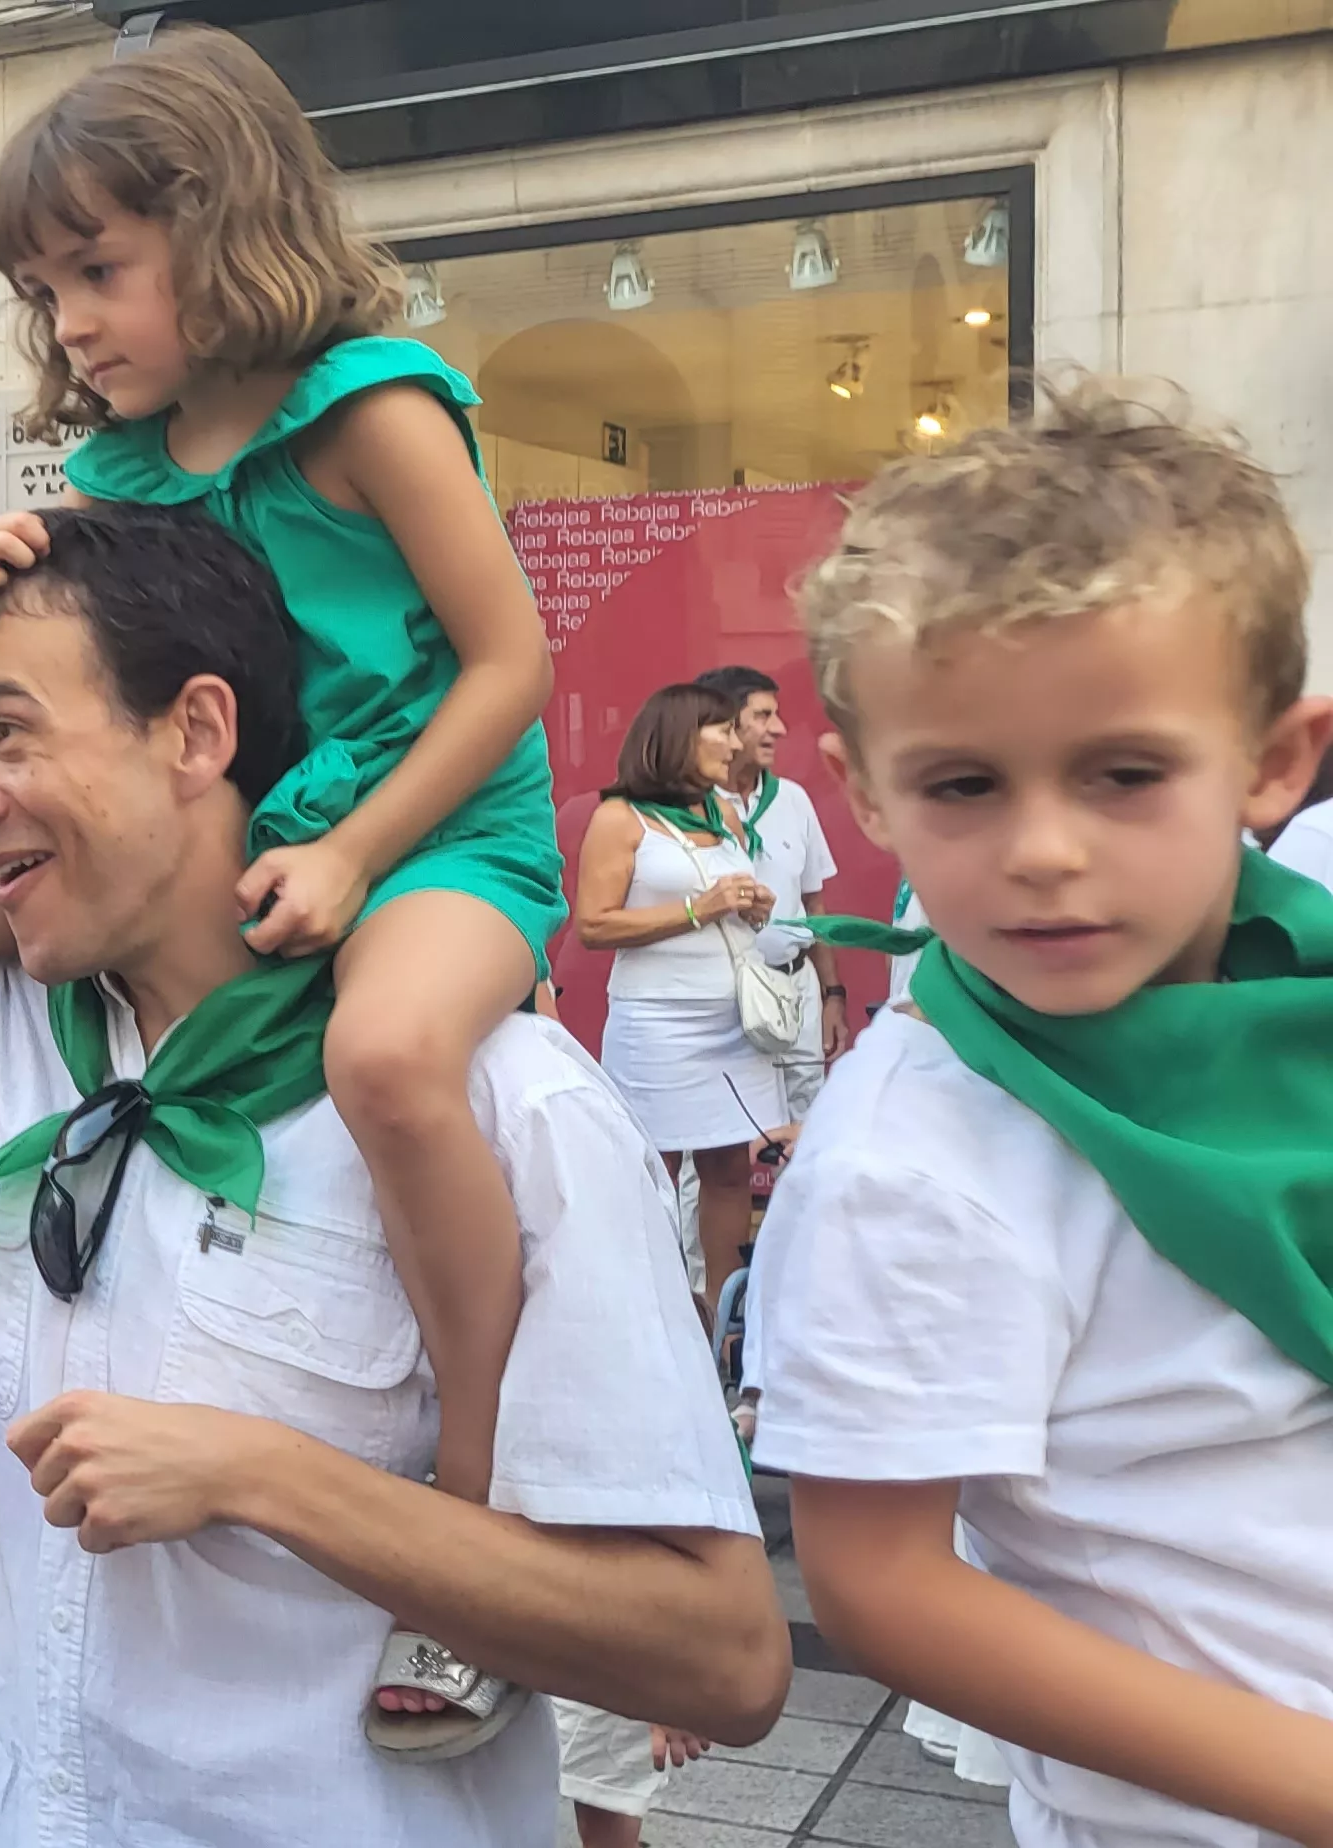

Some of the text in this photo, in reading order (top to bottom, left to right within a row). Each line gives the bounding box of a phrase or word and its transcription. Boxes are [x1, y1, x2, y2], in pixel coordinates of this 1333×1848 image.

[23, 483, 37, 496] Y
[514, 507, 591, 531] Rebajas
[600, 503, 680, 525] Rebajas
[557, 527, 634, 550] Rebajas
